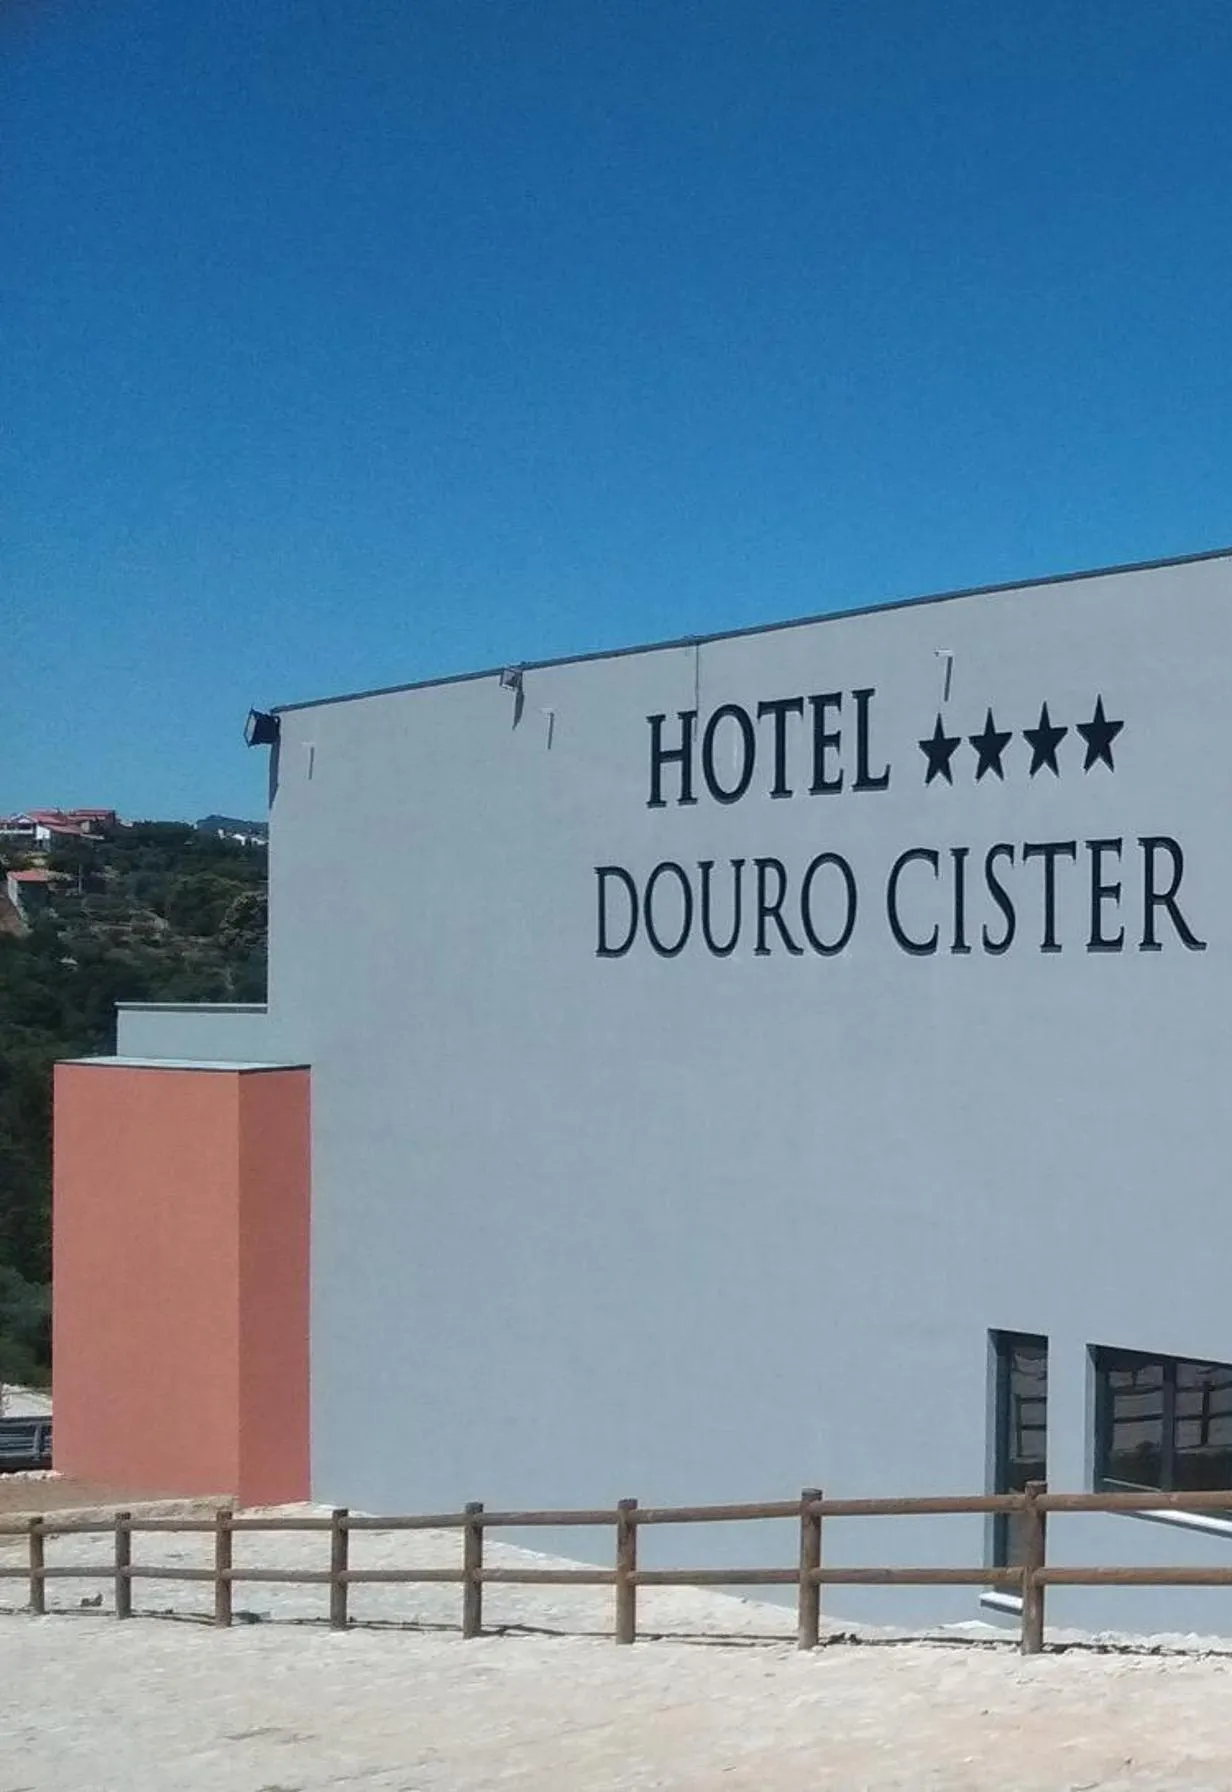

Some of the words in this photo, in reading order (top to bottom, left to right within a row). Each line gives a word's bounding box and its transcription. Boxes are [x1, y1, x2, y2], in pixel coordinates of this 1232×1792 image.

[646, 687, 892, 808] HOTEL
[593, 852, 858, 959] DOURO
[886, 836, 1208, 957] CISTER
